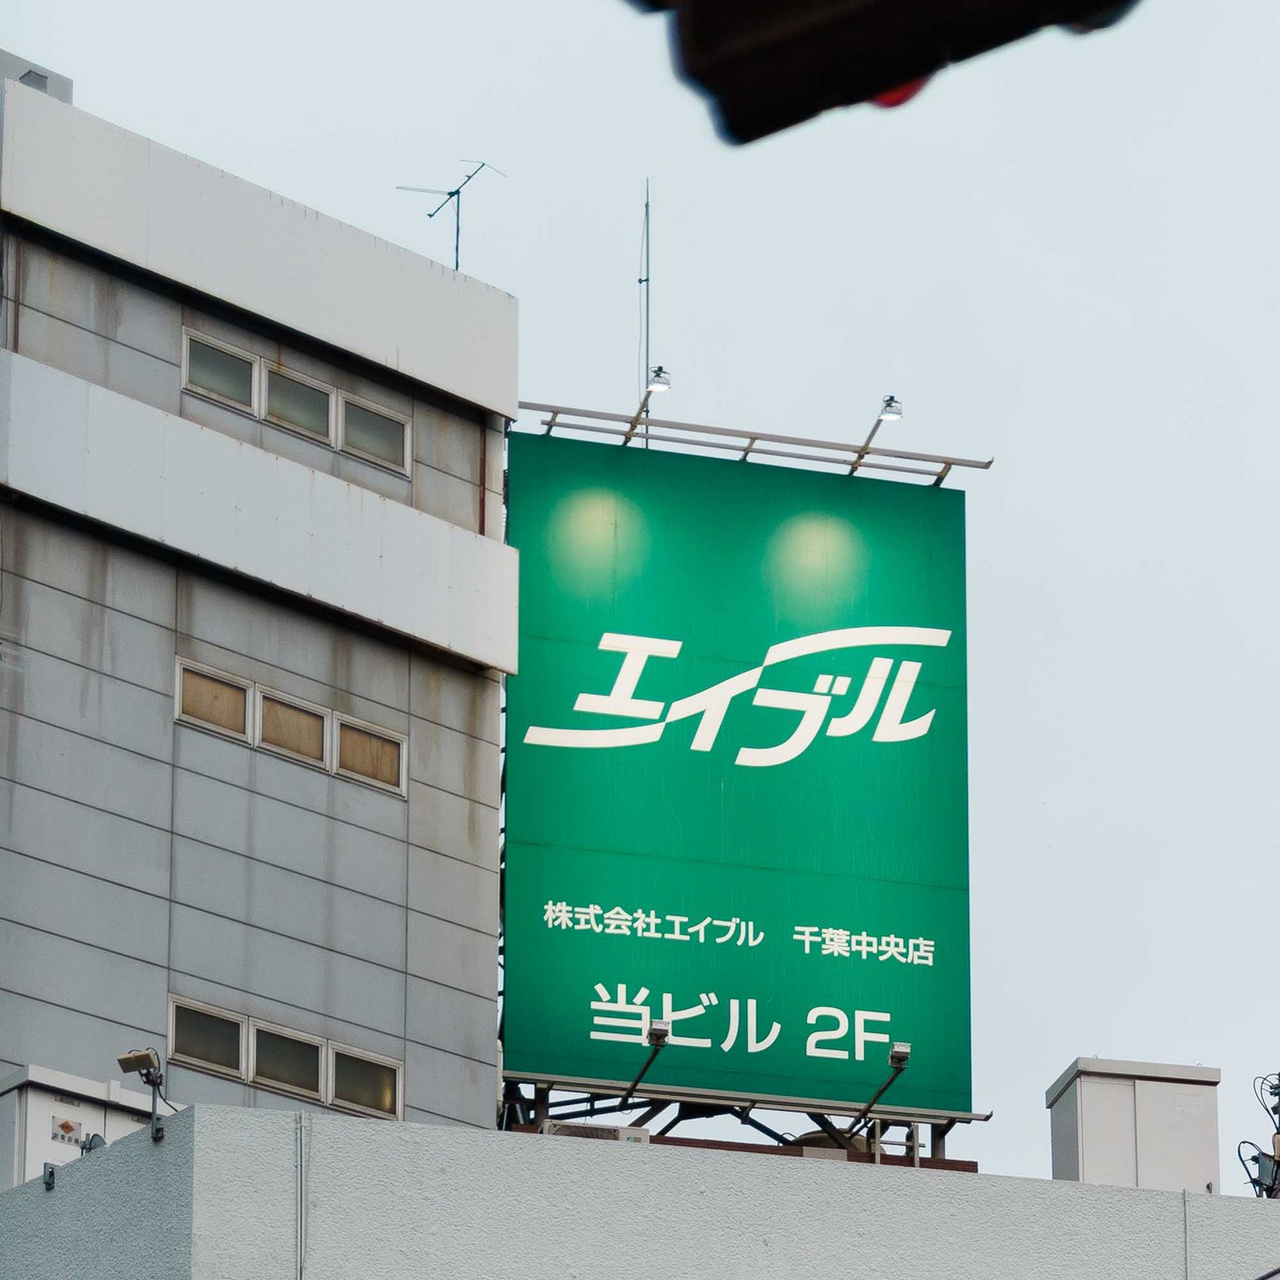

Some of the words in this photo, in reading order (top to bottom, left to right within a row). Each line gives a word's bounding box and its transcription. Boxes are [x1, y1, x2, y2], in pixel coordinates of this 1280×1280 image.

[523, 625, 952, 767] エイブル
[543, 900, 764, 948] 株式会社エイブル
[792, 924, 936, 967] 千葉中央店
[590, 983, 781, 1054] 当ビル
[806, 1006, 892, 1062] 2F
